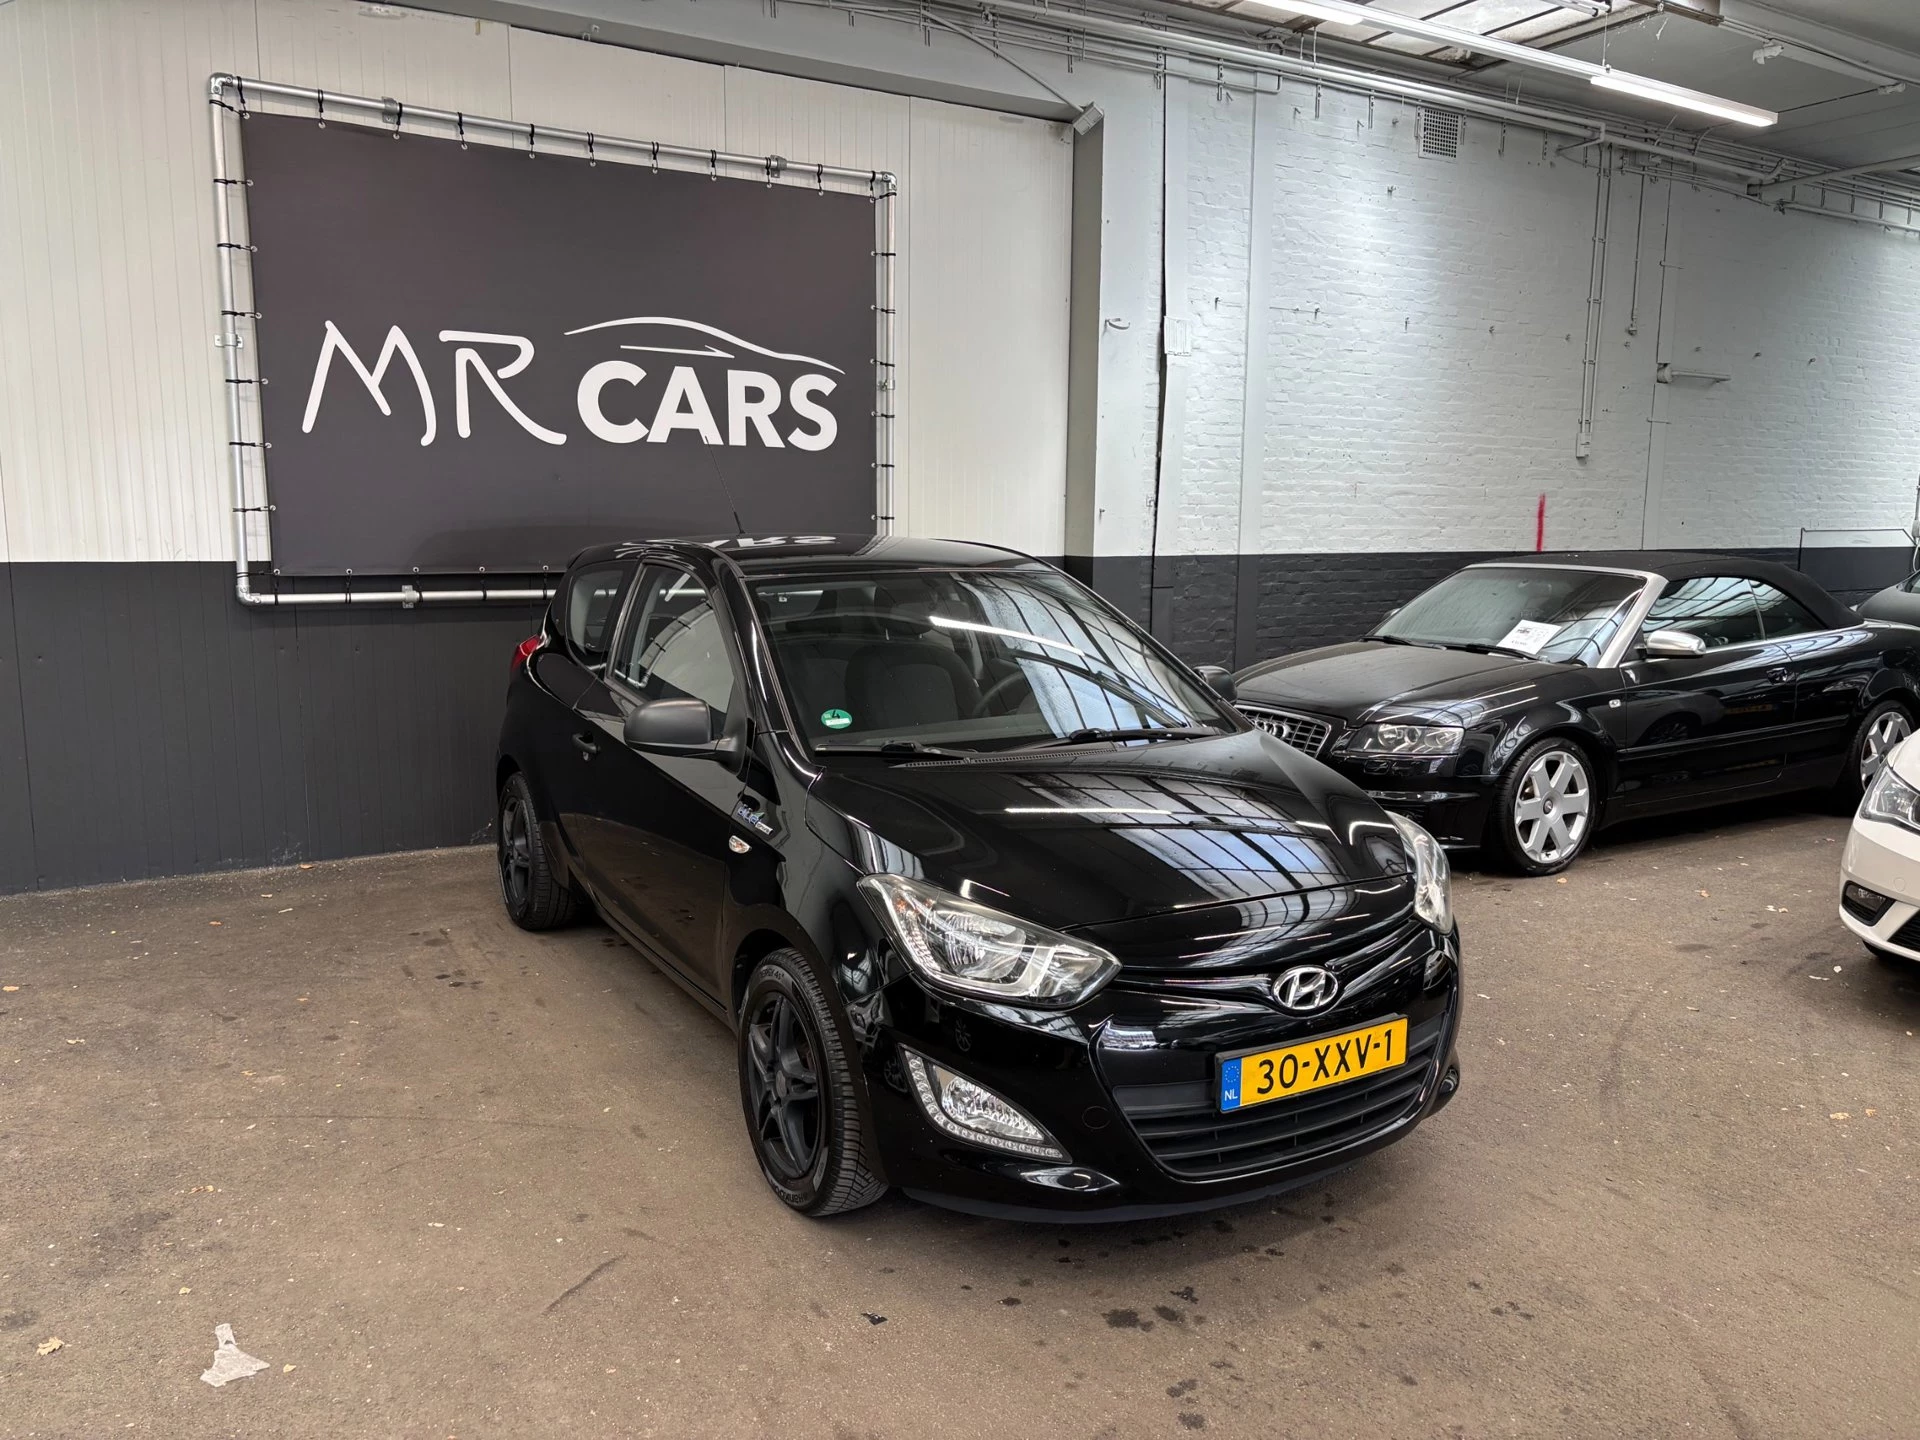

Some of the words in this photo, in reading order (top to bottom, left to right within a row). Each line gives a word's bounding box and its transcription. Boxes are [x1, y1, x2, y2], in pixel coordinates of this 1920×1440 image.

[302, 320, 567, 447] MR
[577, 360, 838, 452] CARS
[1257, 1029, 1392, 1094] 30-XXV-1
[1224, 1090, 1238, 1101] NL
